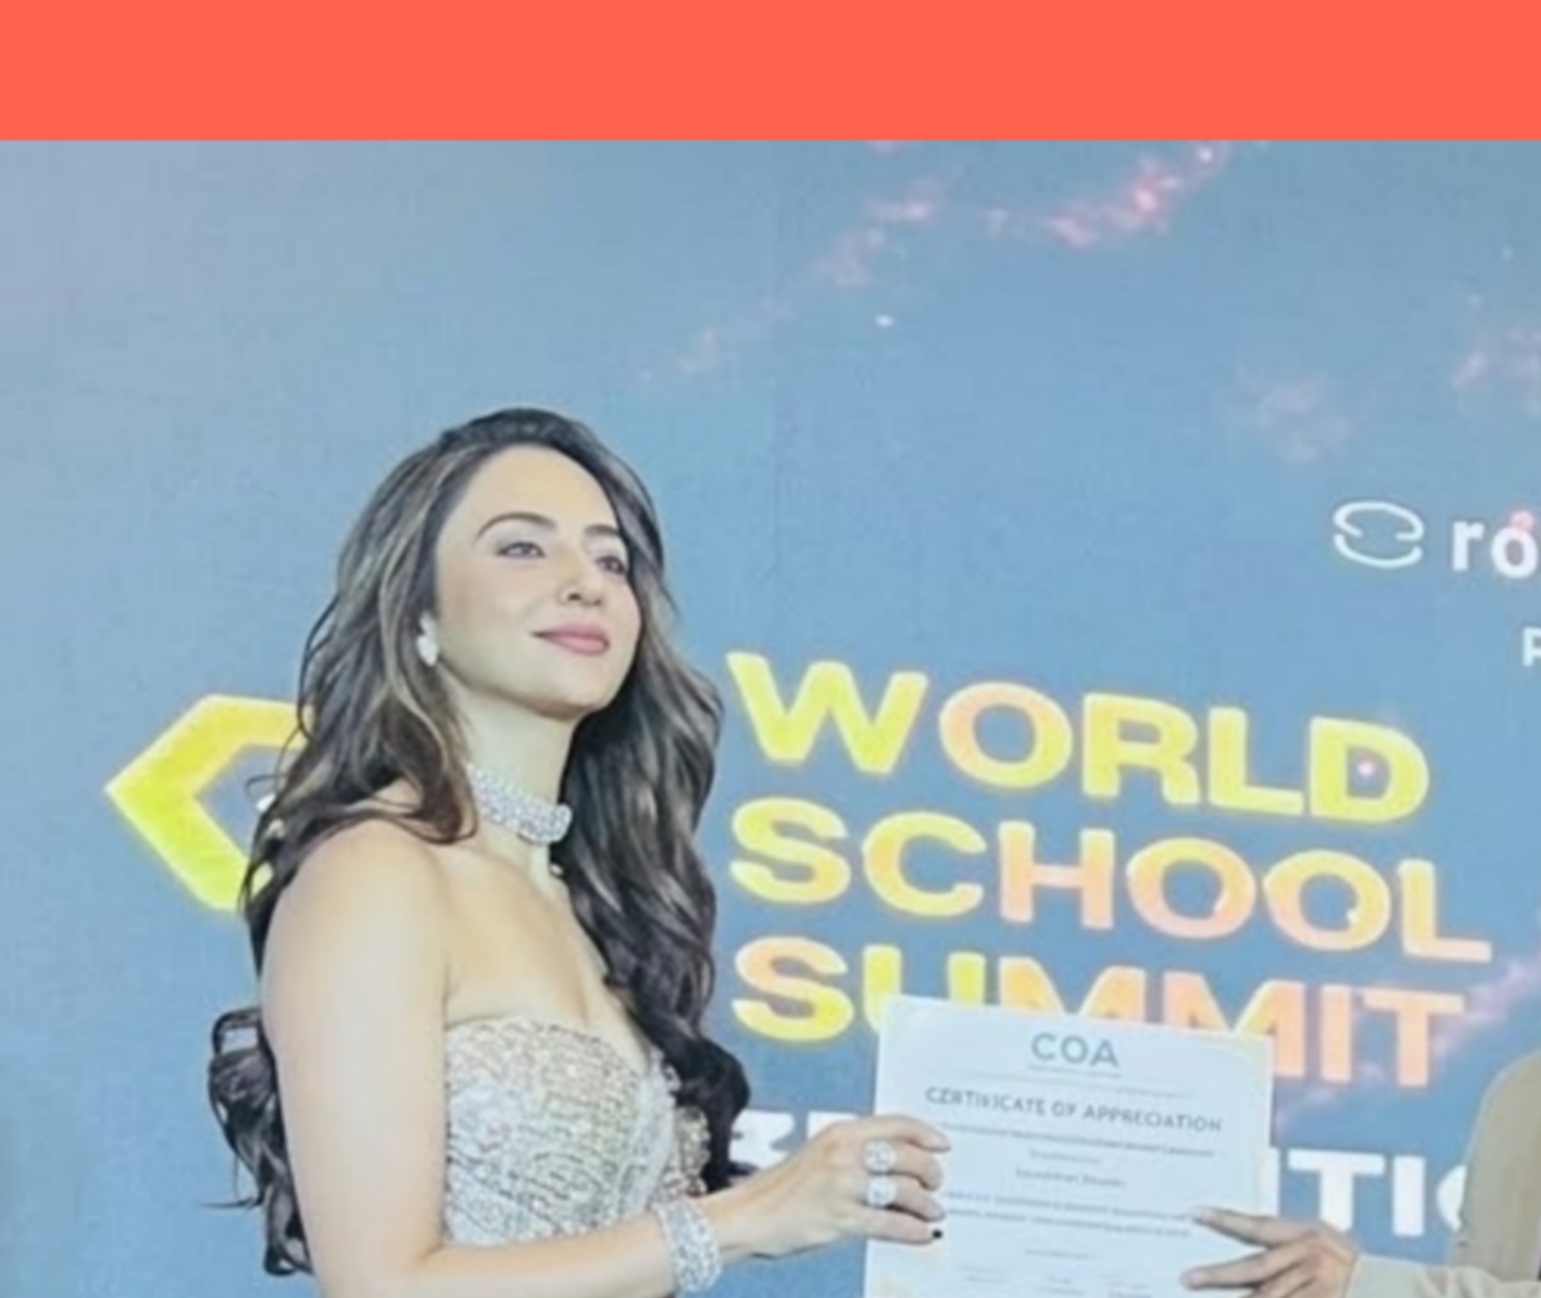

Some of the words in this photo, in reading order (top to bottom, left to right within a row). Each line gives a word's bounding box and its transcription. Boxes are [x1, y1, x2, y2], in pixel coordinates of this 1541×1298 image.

[726, 652, 1430, 824] WORLD
[730, 797, 1492, 962] SCHOOL
[1031, 1031, 1120, 1068] COA
[1082, 1103, 1223, 1133] APPRECIATION
